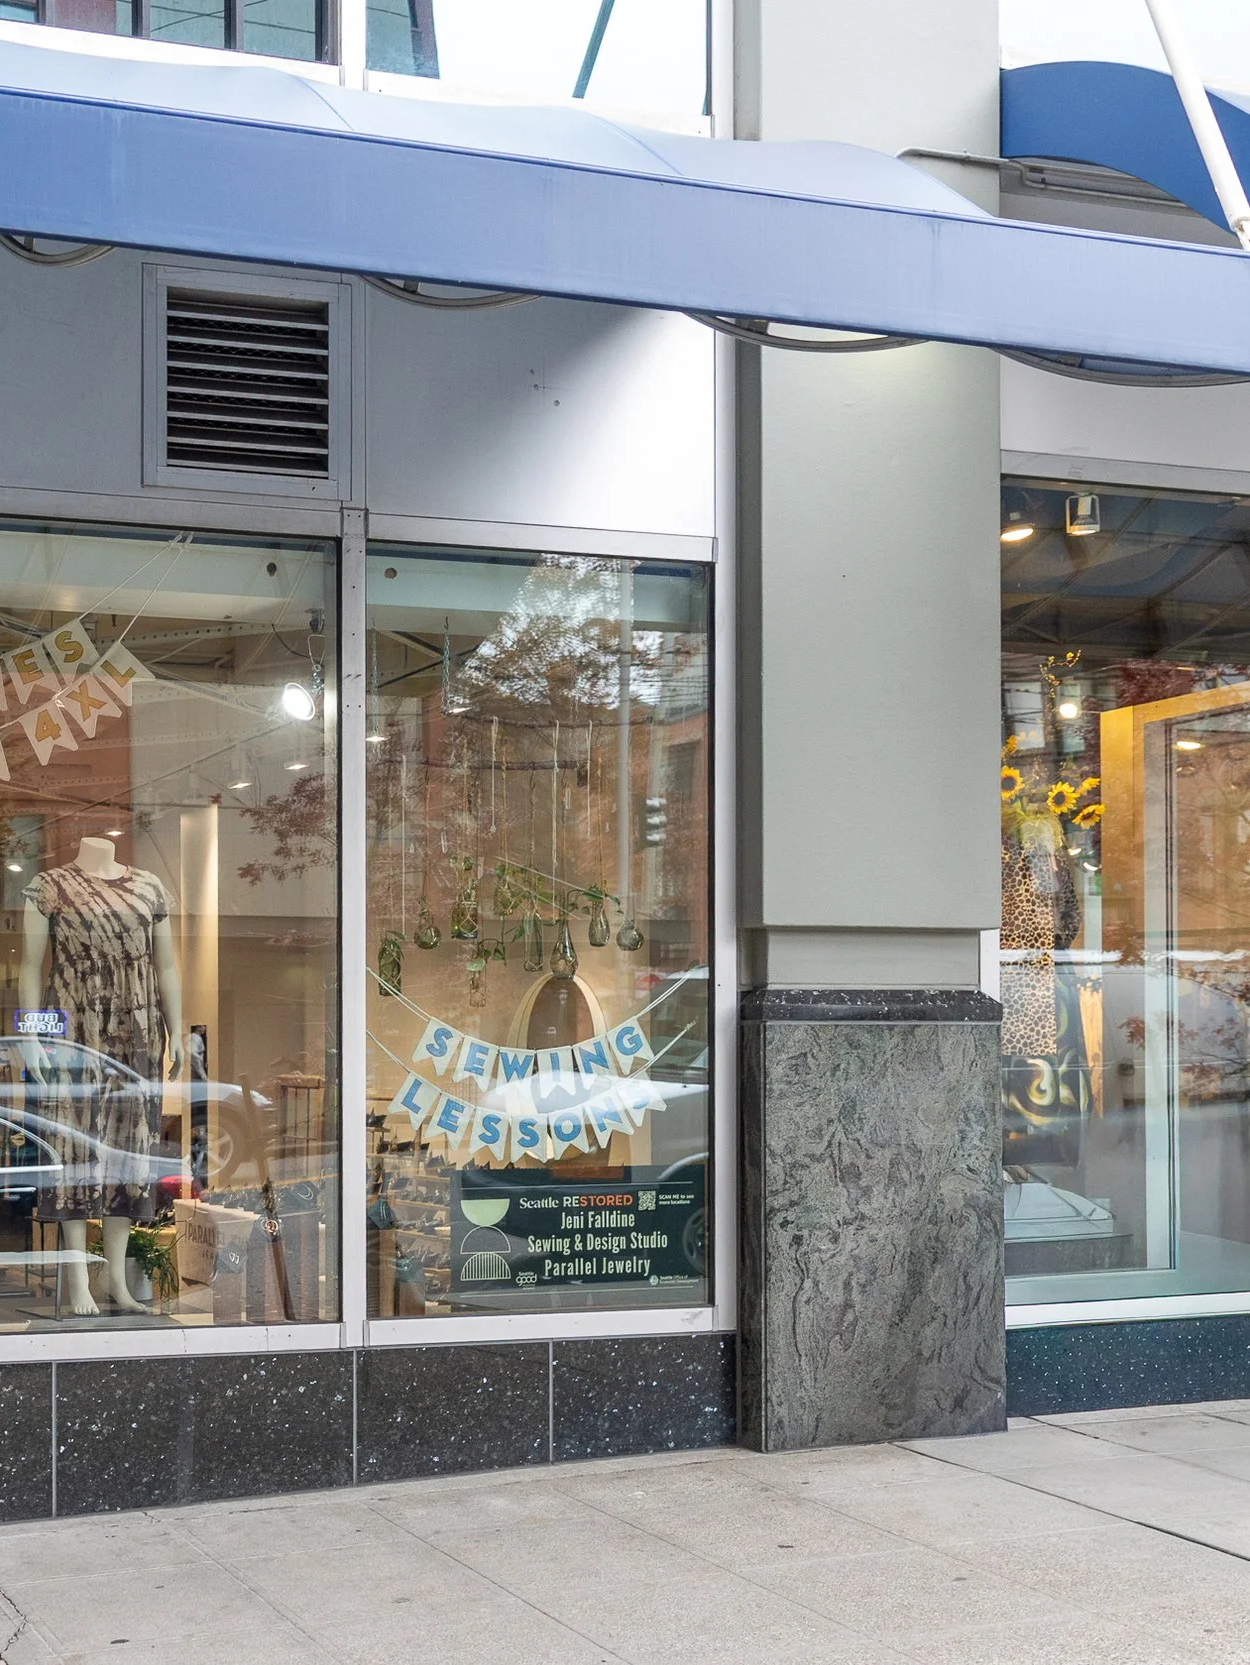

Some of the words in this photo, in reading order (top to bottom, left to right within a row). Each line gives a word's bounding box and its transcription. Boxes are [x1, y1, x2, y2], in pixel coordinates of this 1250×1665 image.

[34, 660, 137, 743] 4XL
[426, 1026, 644, 1083] SEWING
[519, 1197, 559, 1209] Seattle
[563, 1195, 633, 1207] RESTORED
[561, 1211, 584, 1229] Jeni
[588, 1210, 635, 1228] Falldine
[527, 1234, 571, 1255] Sewing
[574, 1233, 583, 1251] &
[586, 1232, 626, 1253] Design
[630, 1231, 668, 1249] Studio
[544, 1257, 597, 1277] Parallel
[601, 1256, 651, 1276] Jewelry
[515, 1273, 538, 1286] good
